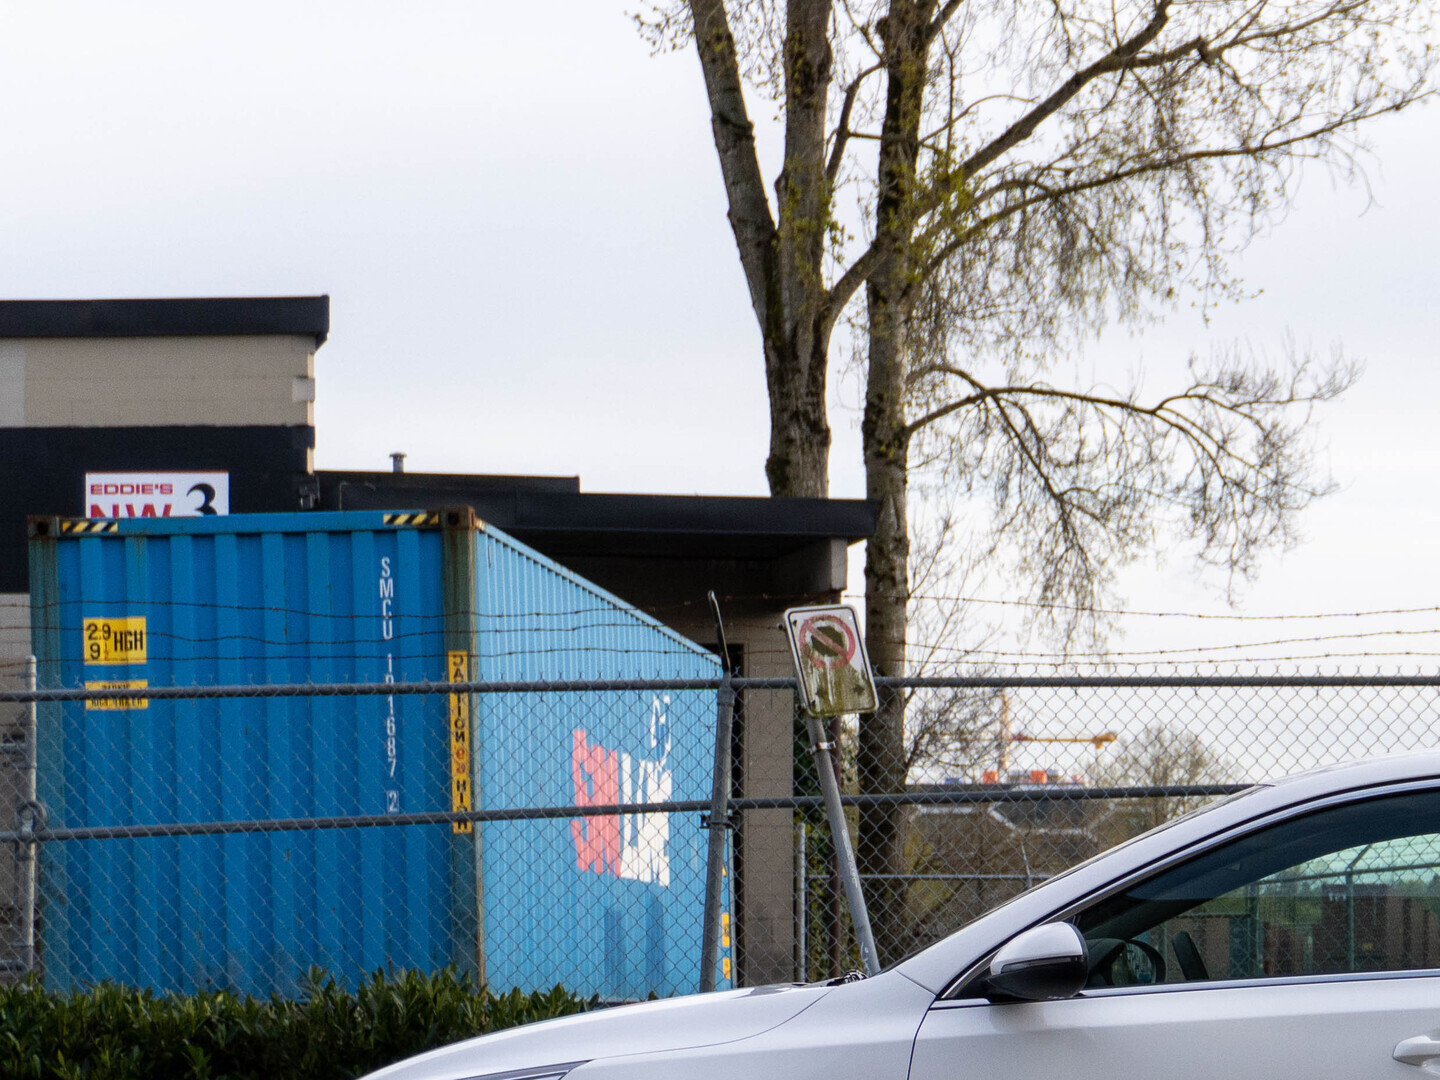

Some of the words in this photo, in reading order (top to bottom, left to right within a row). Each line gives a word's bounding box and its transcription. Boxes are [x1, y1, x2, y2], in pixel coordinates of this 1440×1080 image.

[90, 483, 173, 495] EDDIE'S
[186, 482, 218, 516] 3
[113, 630, 144, 653] HGH
[379, 556, 393, 640] SMCU
[388, 791, 398, 813] 2
